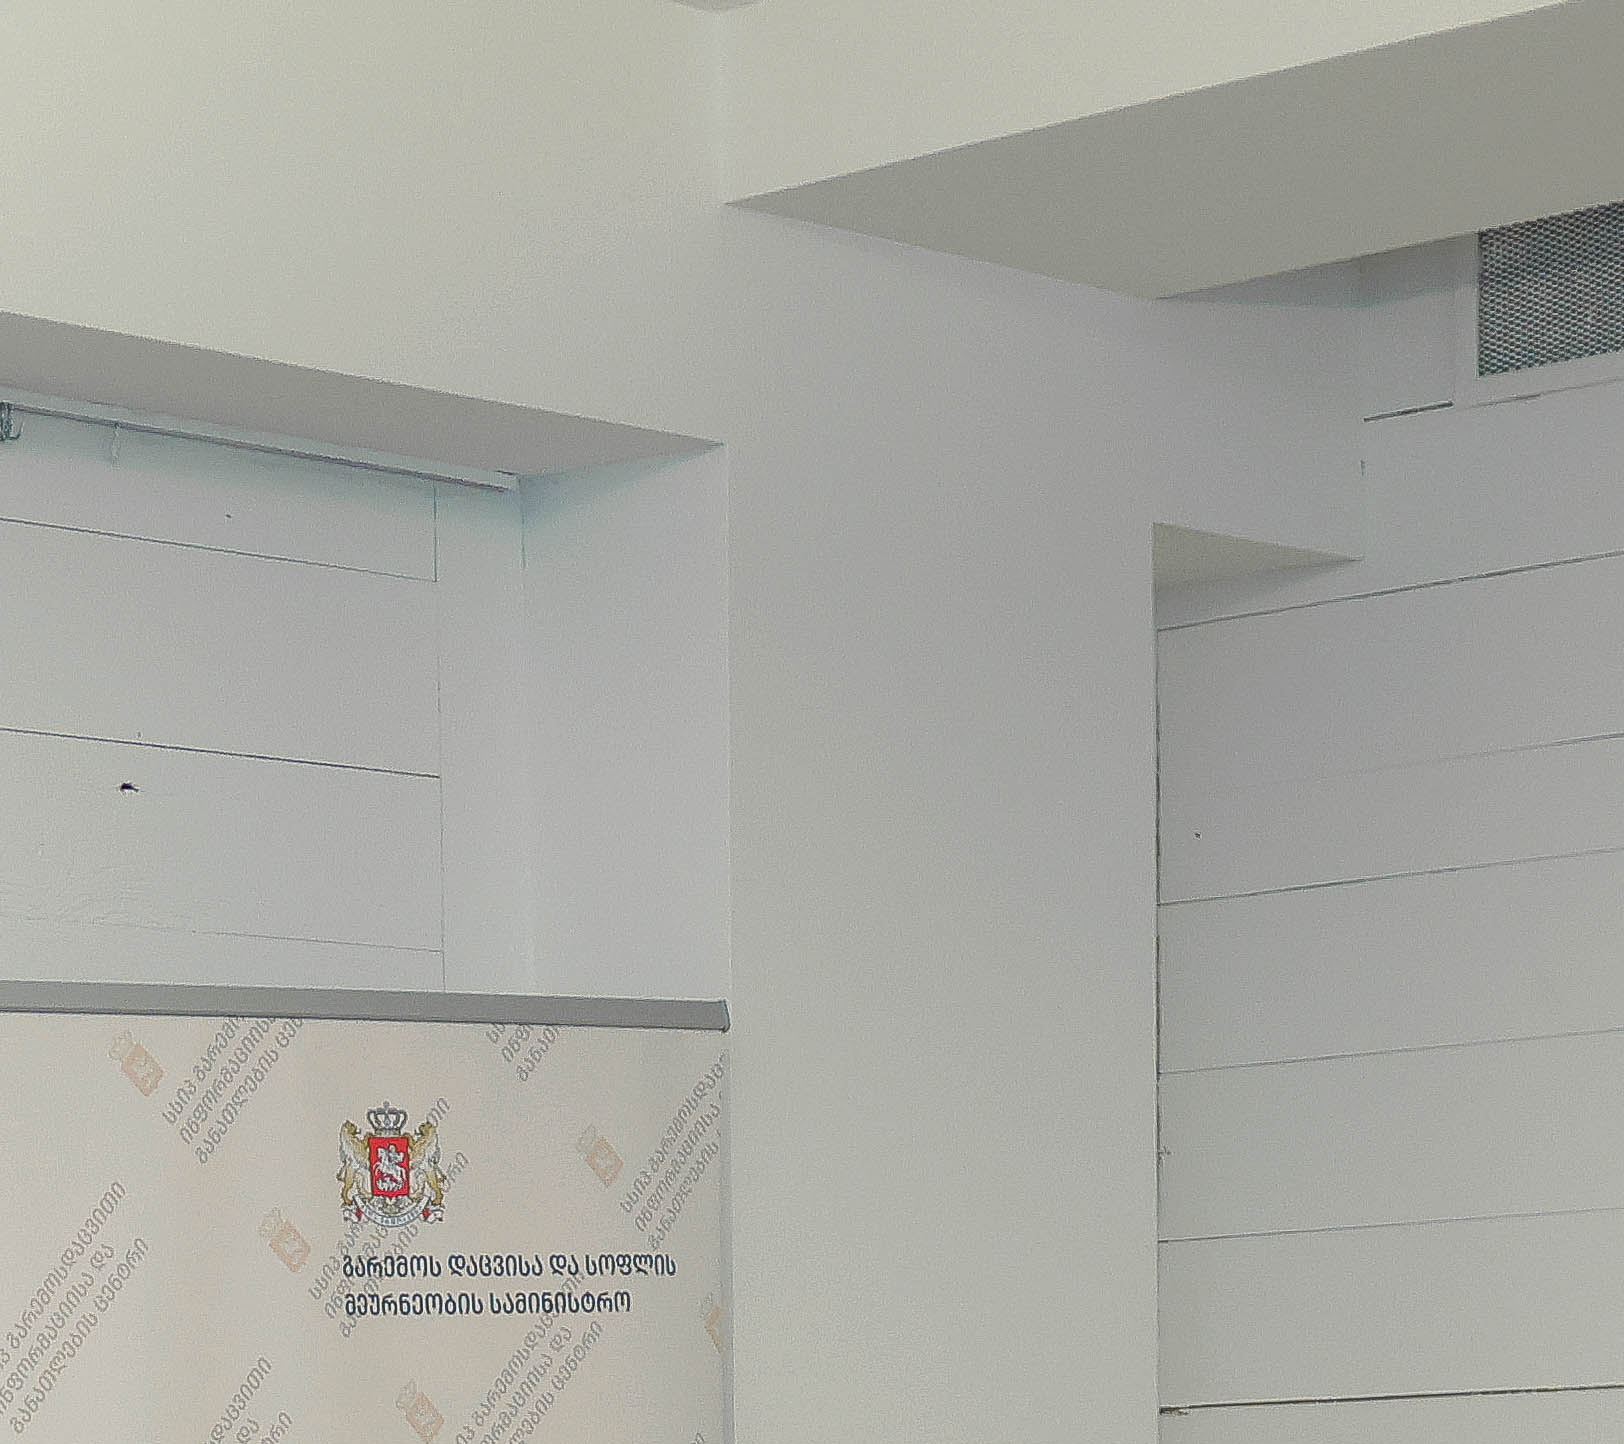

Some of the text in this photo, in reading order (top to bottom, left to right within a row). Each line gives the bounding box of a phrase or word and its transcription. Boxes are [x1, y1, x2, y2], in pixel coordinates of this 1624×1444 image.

[163, 1080, 197, 1124] სსიპ
[195, 1049, 278, 1163] განათლების
[621, 1171, 651, 1213] სსიპ
[7, 1182, 126, 1349] გარემოსდაცვითი
[90, 1244, 114, 1271] და
[342, 1253, 677, 1277] გარემოს დაცვისა და სოფლის
[345, 1290, 631, 1317] მეურნეობის სამინისტრო
[10, 1238, 148, 1434] განათლების ცენტრი
[552, 1327, 572, 1351] და
[552, 1320, 603, 1392] ცენტრი
[236, 1418, 259, 1444] და
